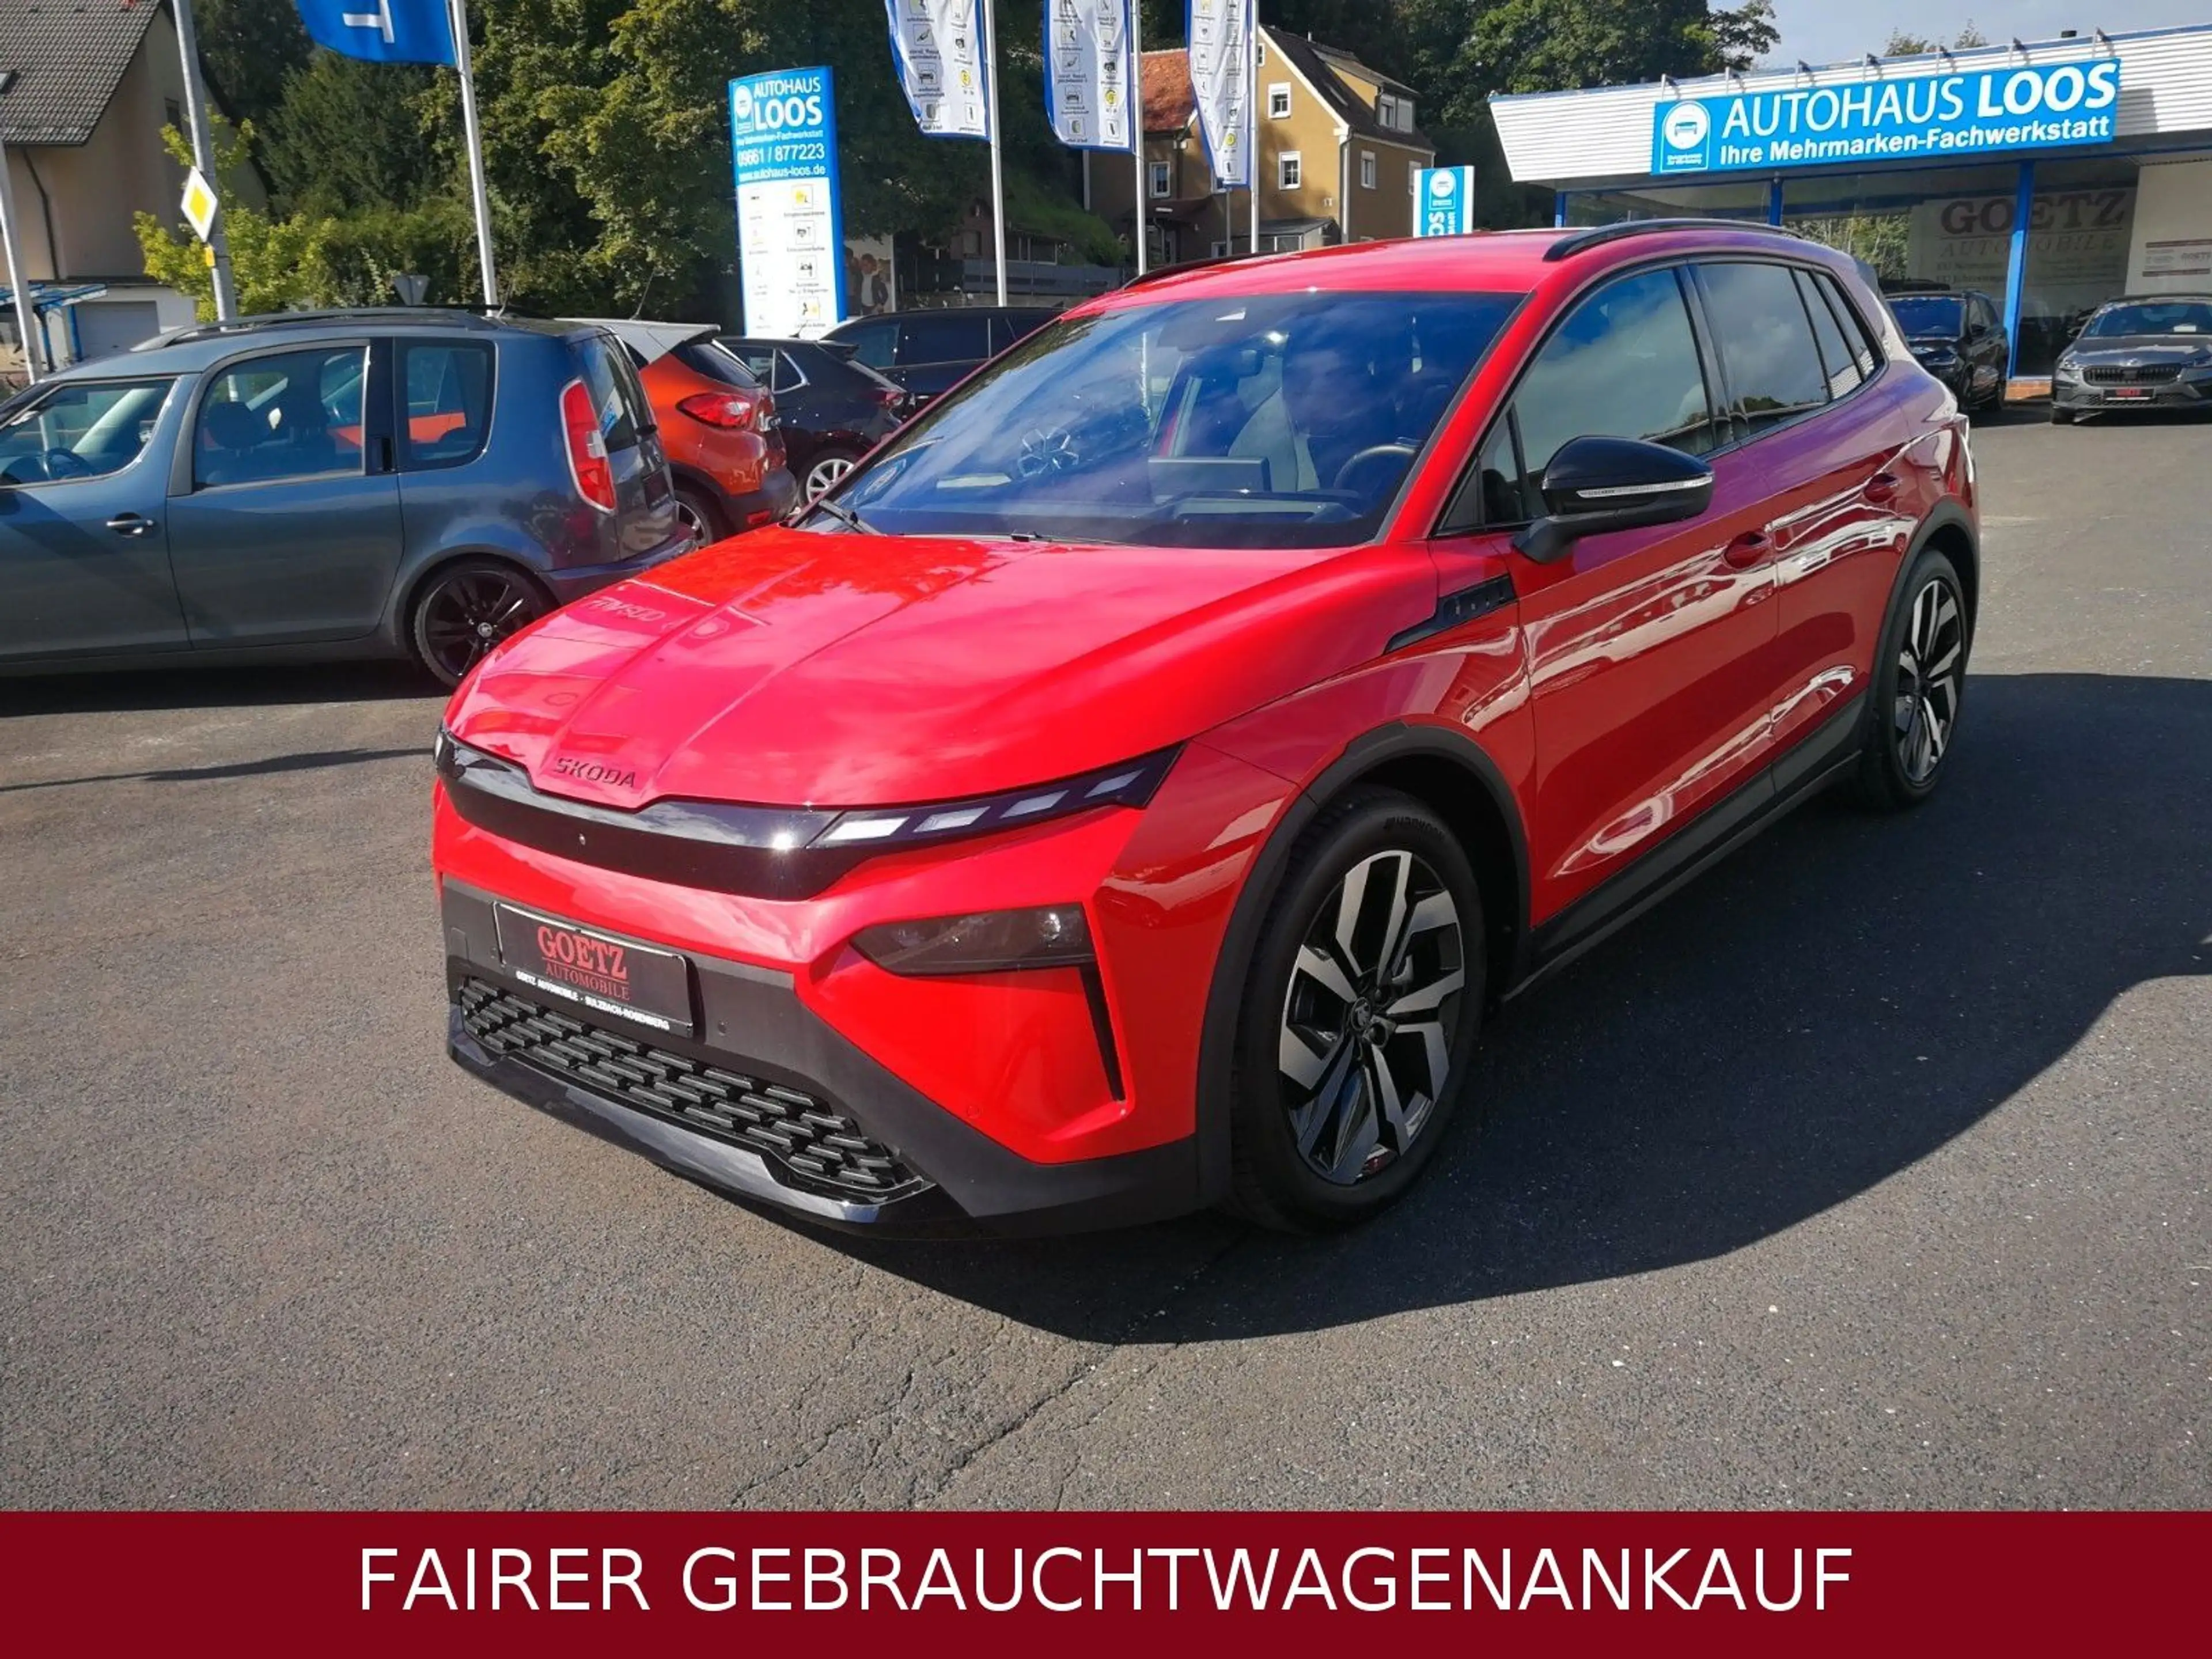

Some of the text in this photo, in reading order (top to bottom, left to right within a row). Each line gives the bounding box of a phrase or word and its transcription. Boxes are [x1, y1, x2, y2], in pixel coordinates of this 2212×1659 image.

[753, 77, 821, 99] AUTOHAUS
[1722, 63, 2119, 141] AUTOHAUS LOOS
[754, 95, 823, 131] LOOS
[775, 143, 825, 162] 877223
[1720, 116, 2110, 165] Ihre Mehrmarken-Fachwerkstatt
[1941, 191, 2127, 234] GOETZ
[1940, 235, 2115, 257] AUTOOBILE
[537, 926, 627, 979] GOETZ
[546, 962, 630, 1001] AUTOMOBILE
